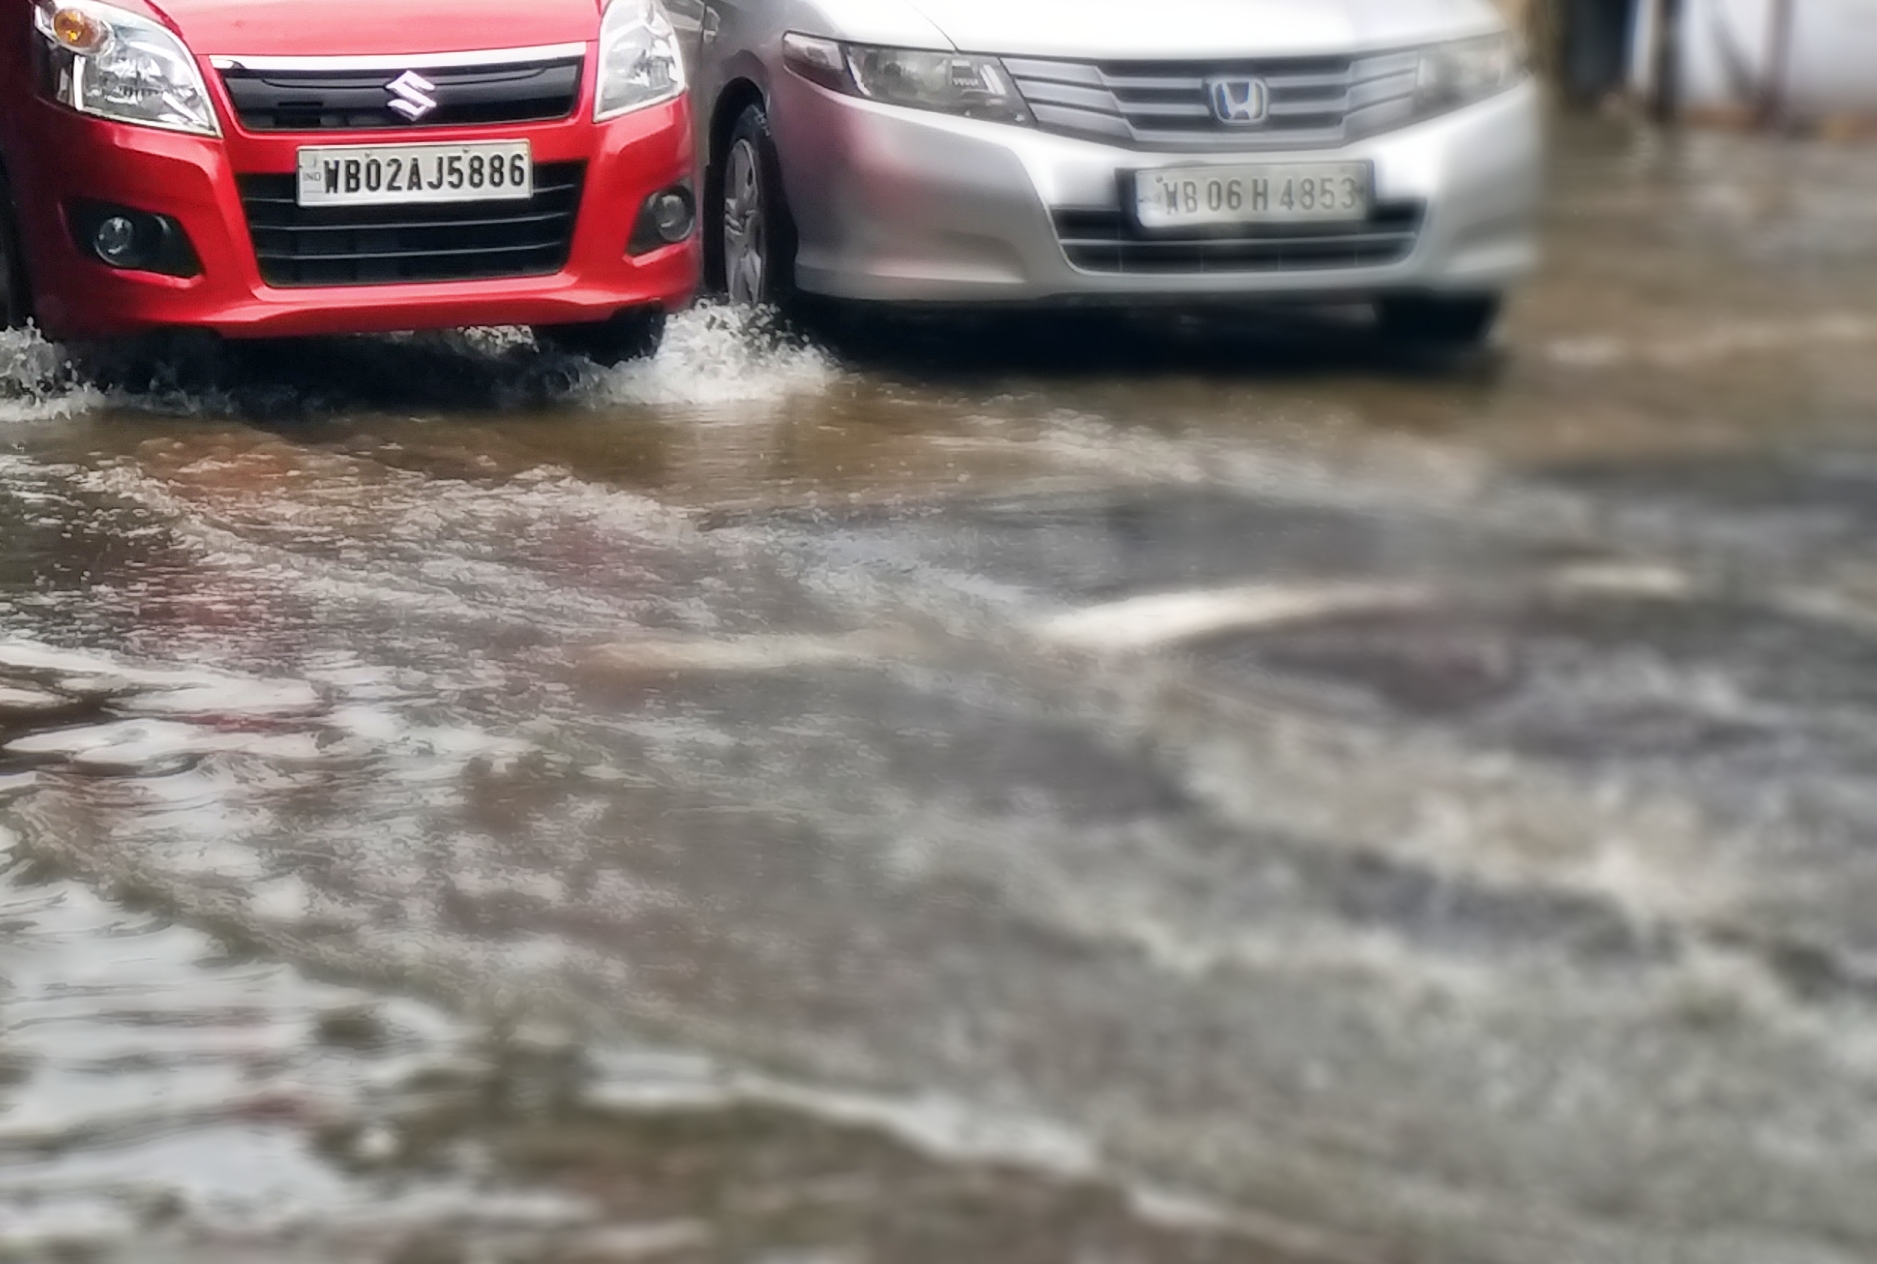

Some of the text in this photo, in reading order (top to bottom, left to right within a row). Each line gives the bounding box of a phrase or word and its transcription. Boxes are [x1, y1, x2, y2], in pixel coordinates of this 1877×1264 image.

[323, 153, 526, 194] WB02AJ5886
[1163, 176, 1357, 214] WB 06 H 4853
